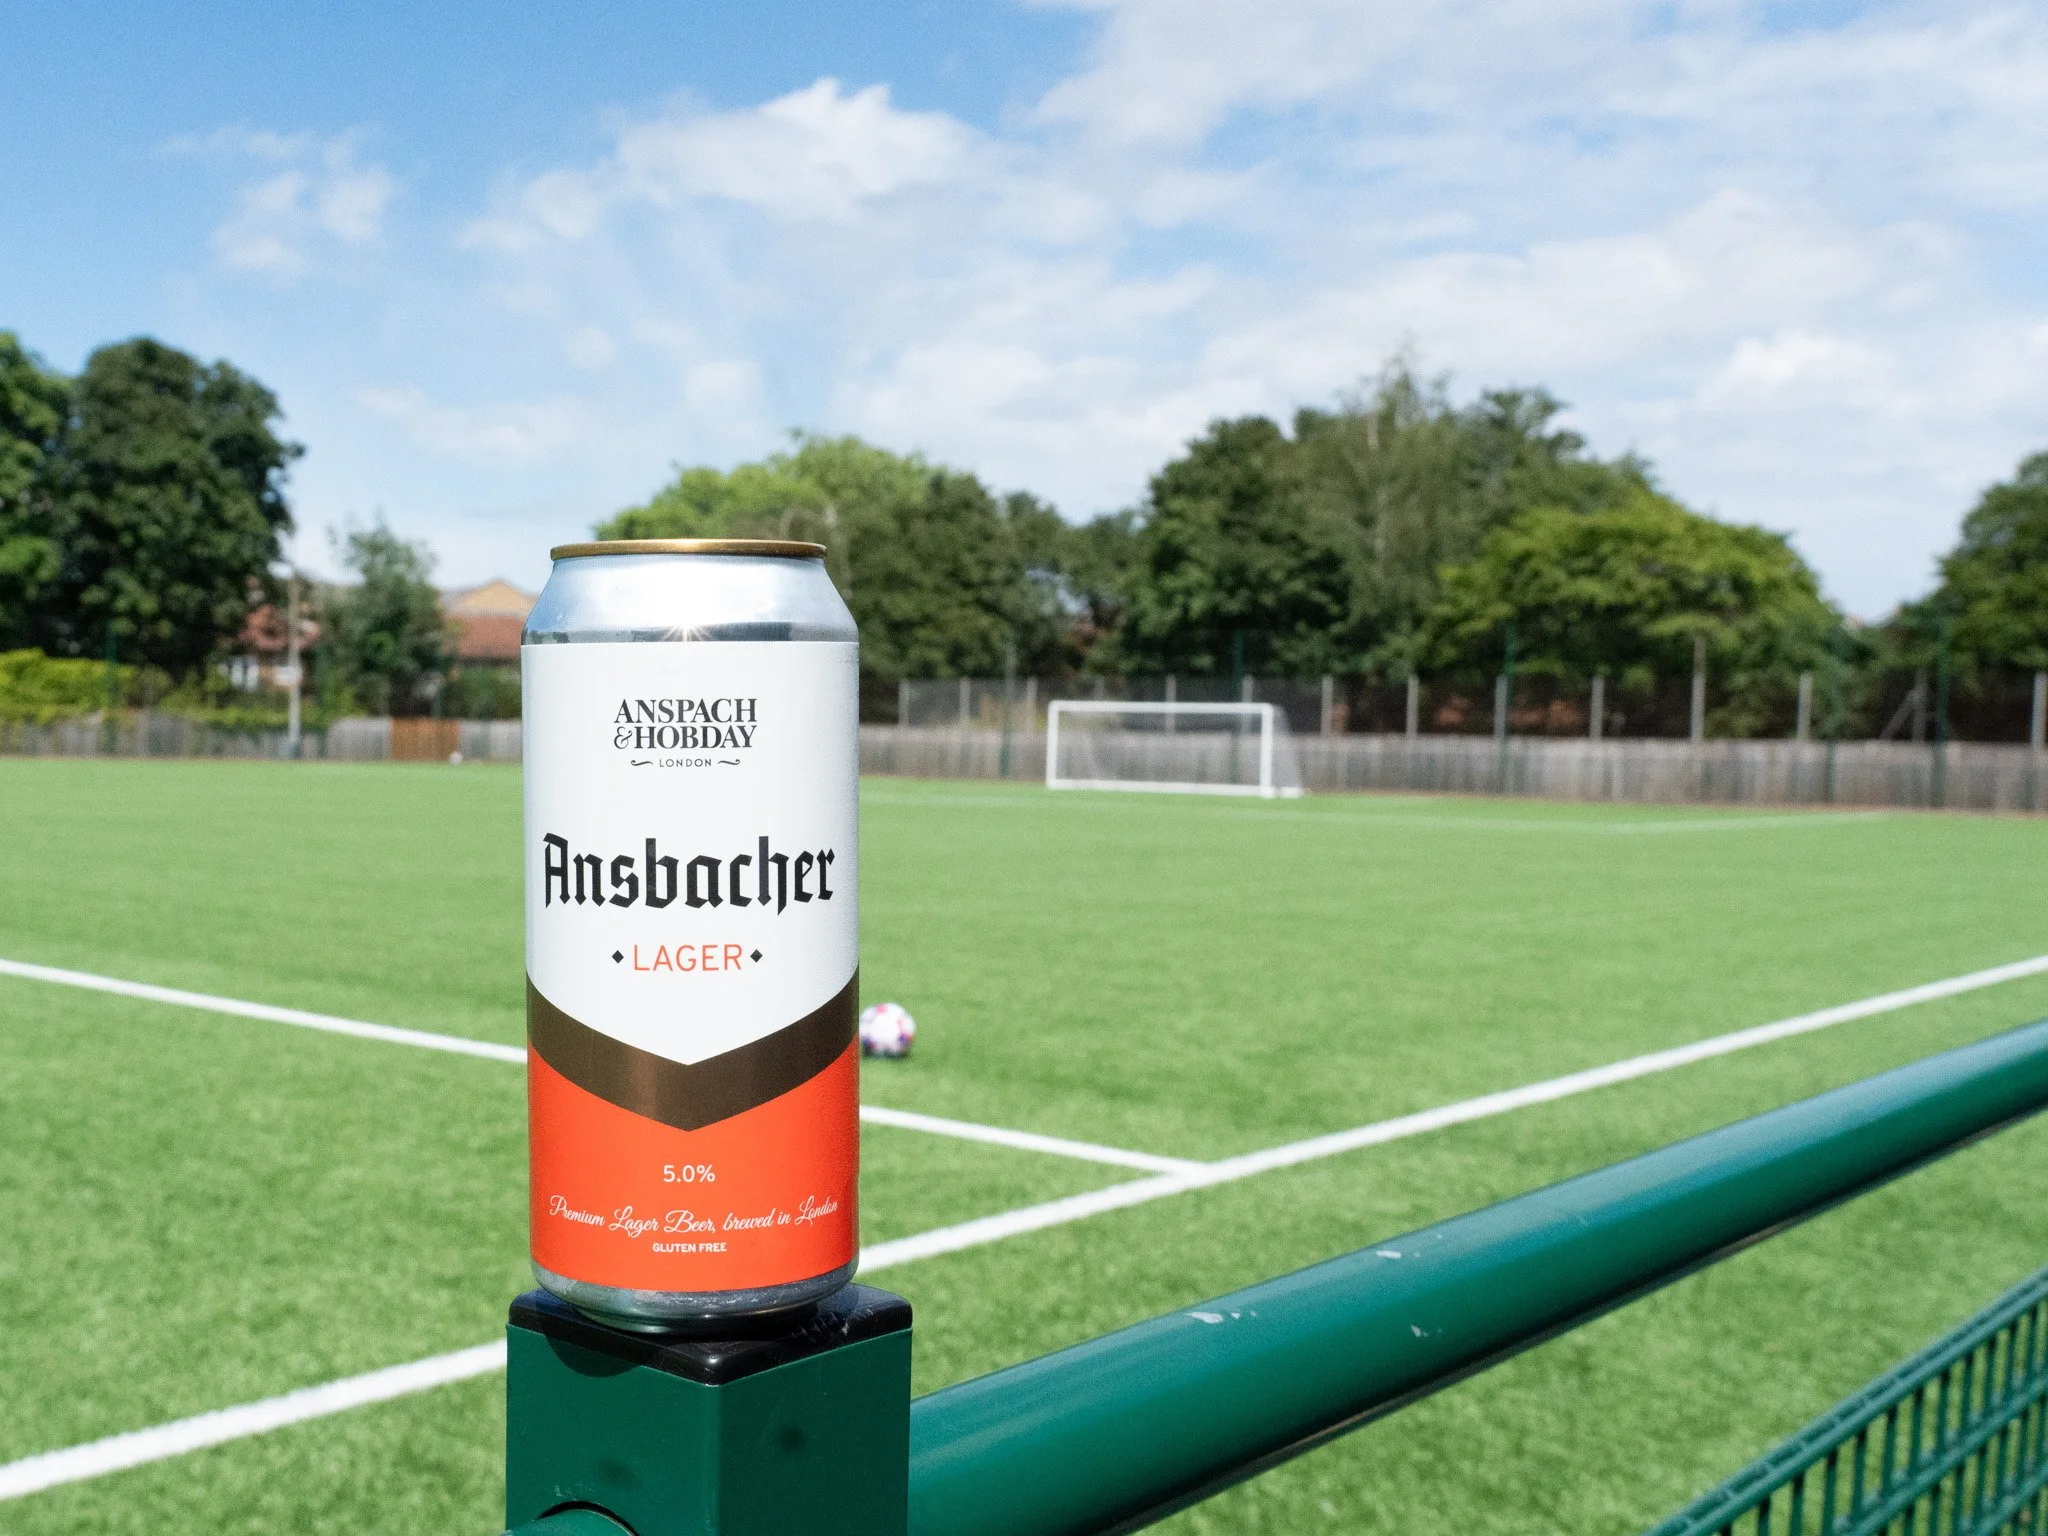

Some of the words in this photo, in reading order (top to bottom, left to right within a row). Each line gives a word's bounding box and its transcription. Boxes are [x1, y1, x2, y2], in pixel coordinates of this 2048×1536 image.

[613, 698, 758, 724] ANSPACH
[659, 758, 712, 768] LONDON
[543, 832, 835, 916] Ansbacher
[633, 944, 743, 972] LAGER
[663, 1164, 716, 1183] 5.0%
[549, 1194, 606, 1227] Premium
[608, 1205, 660, 1238] Lager
[722, 1208, 775, 1231] brewed
[777, 1208, 791, 1225] in
[794, 1195, 839, 1227] London
[652, 1242, 696, 1253] GLUTEN
[699, 1242, 727, 1252] FREE
